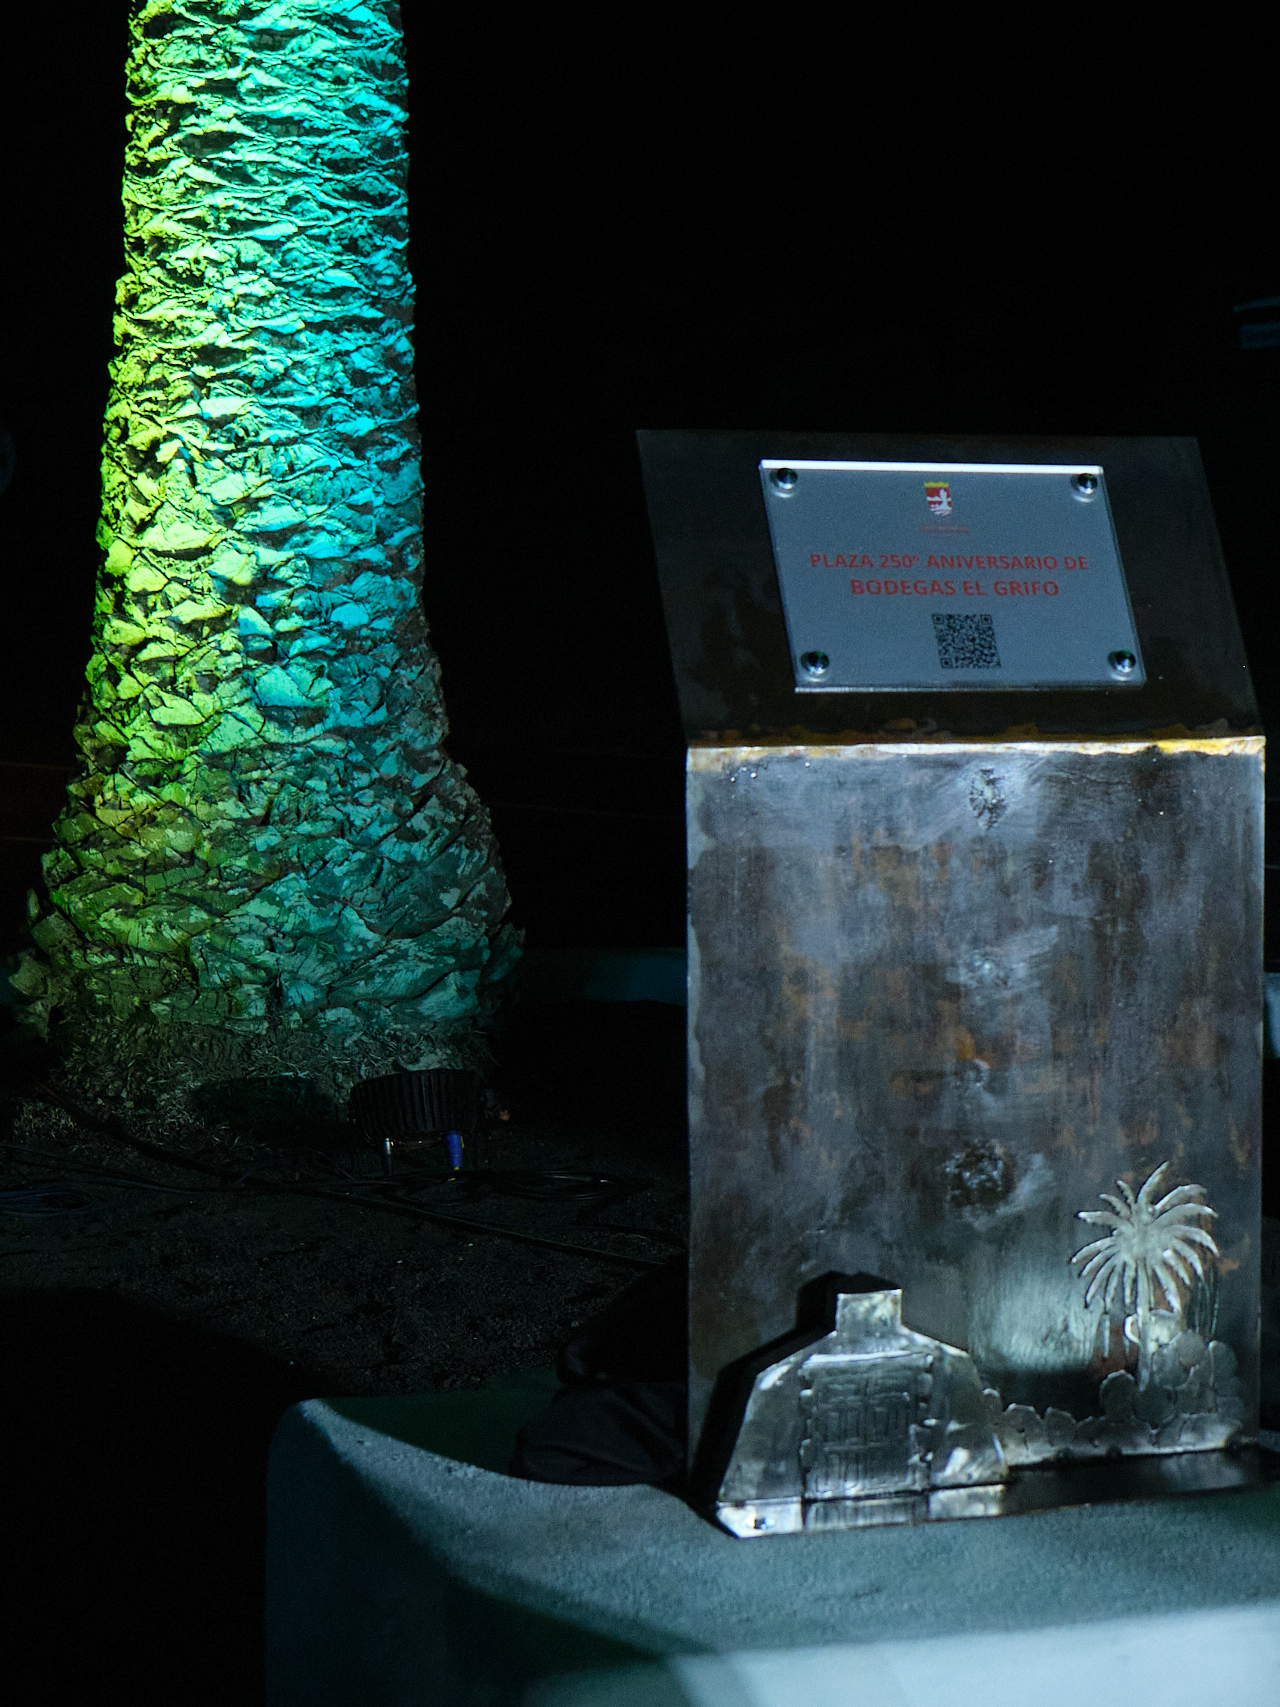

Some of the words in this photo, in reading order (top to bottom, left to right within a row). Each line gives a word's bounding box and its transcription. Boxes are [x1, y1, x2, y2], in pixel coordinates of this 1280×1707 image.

[810, 553, 873, 569] PLAZA
[926, 554, 1058, 570] ANIVERSARIO
[1064, 556, 1088, 570] DE
[850, 579, 956, 596] BODEGAS
[963, 580, 987, 596] EL
[994, 580, 1060, 597] GRIFO
